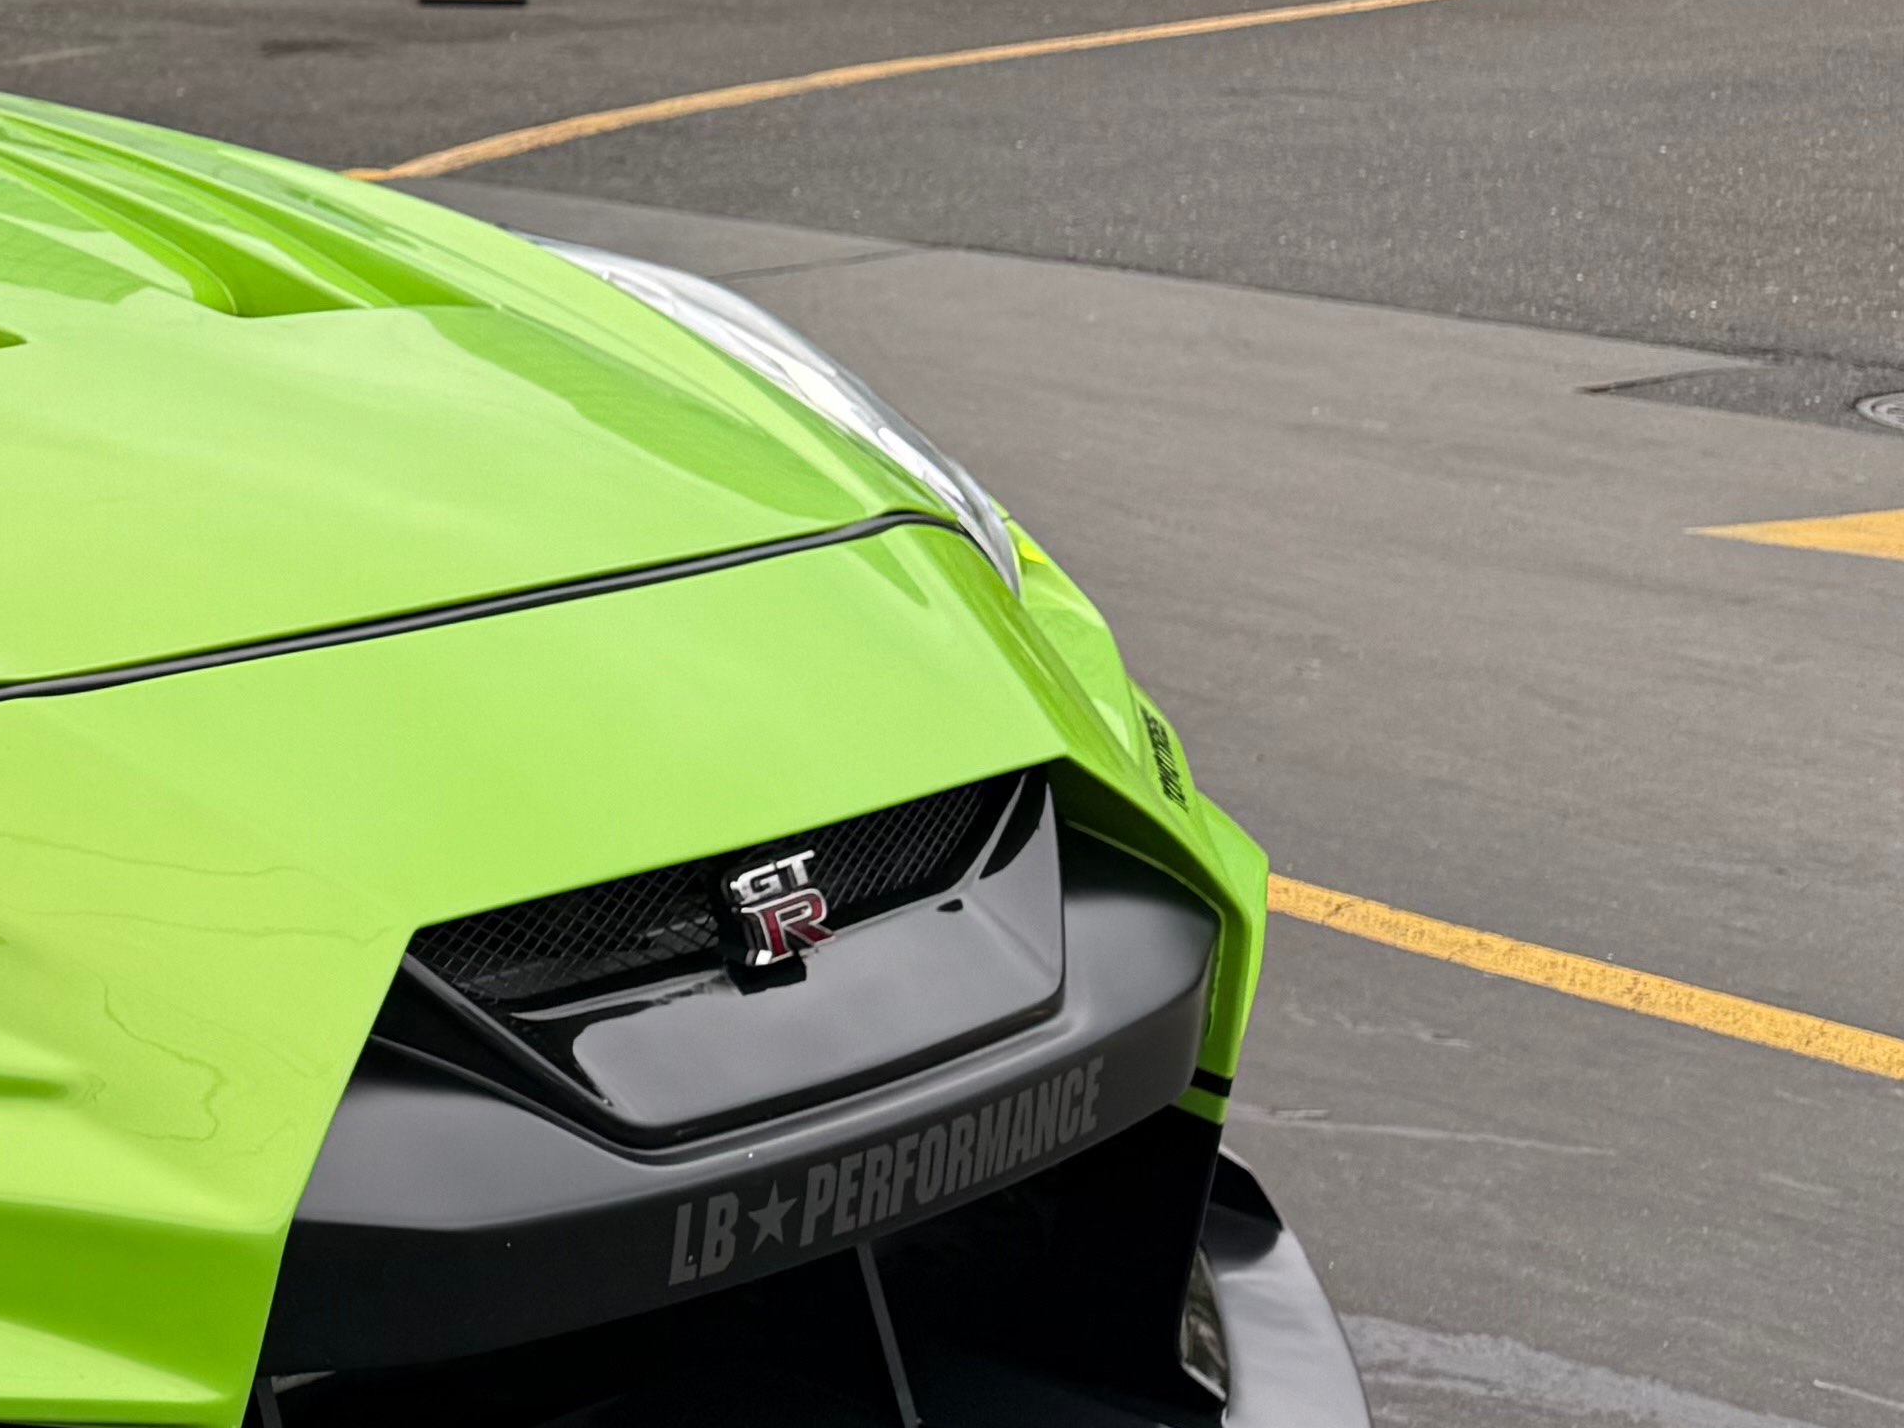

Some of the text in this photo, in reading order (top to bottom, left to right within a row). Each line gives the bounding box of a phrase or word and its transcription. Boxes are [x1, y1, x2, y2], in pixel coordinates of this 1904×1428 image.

[741, 888, 835, 966] R
[668, 1055, 1105, 1287] LB PERFORMANCE
